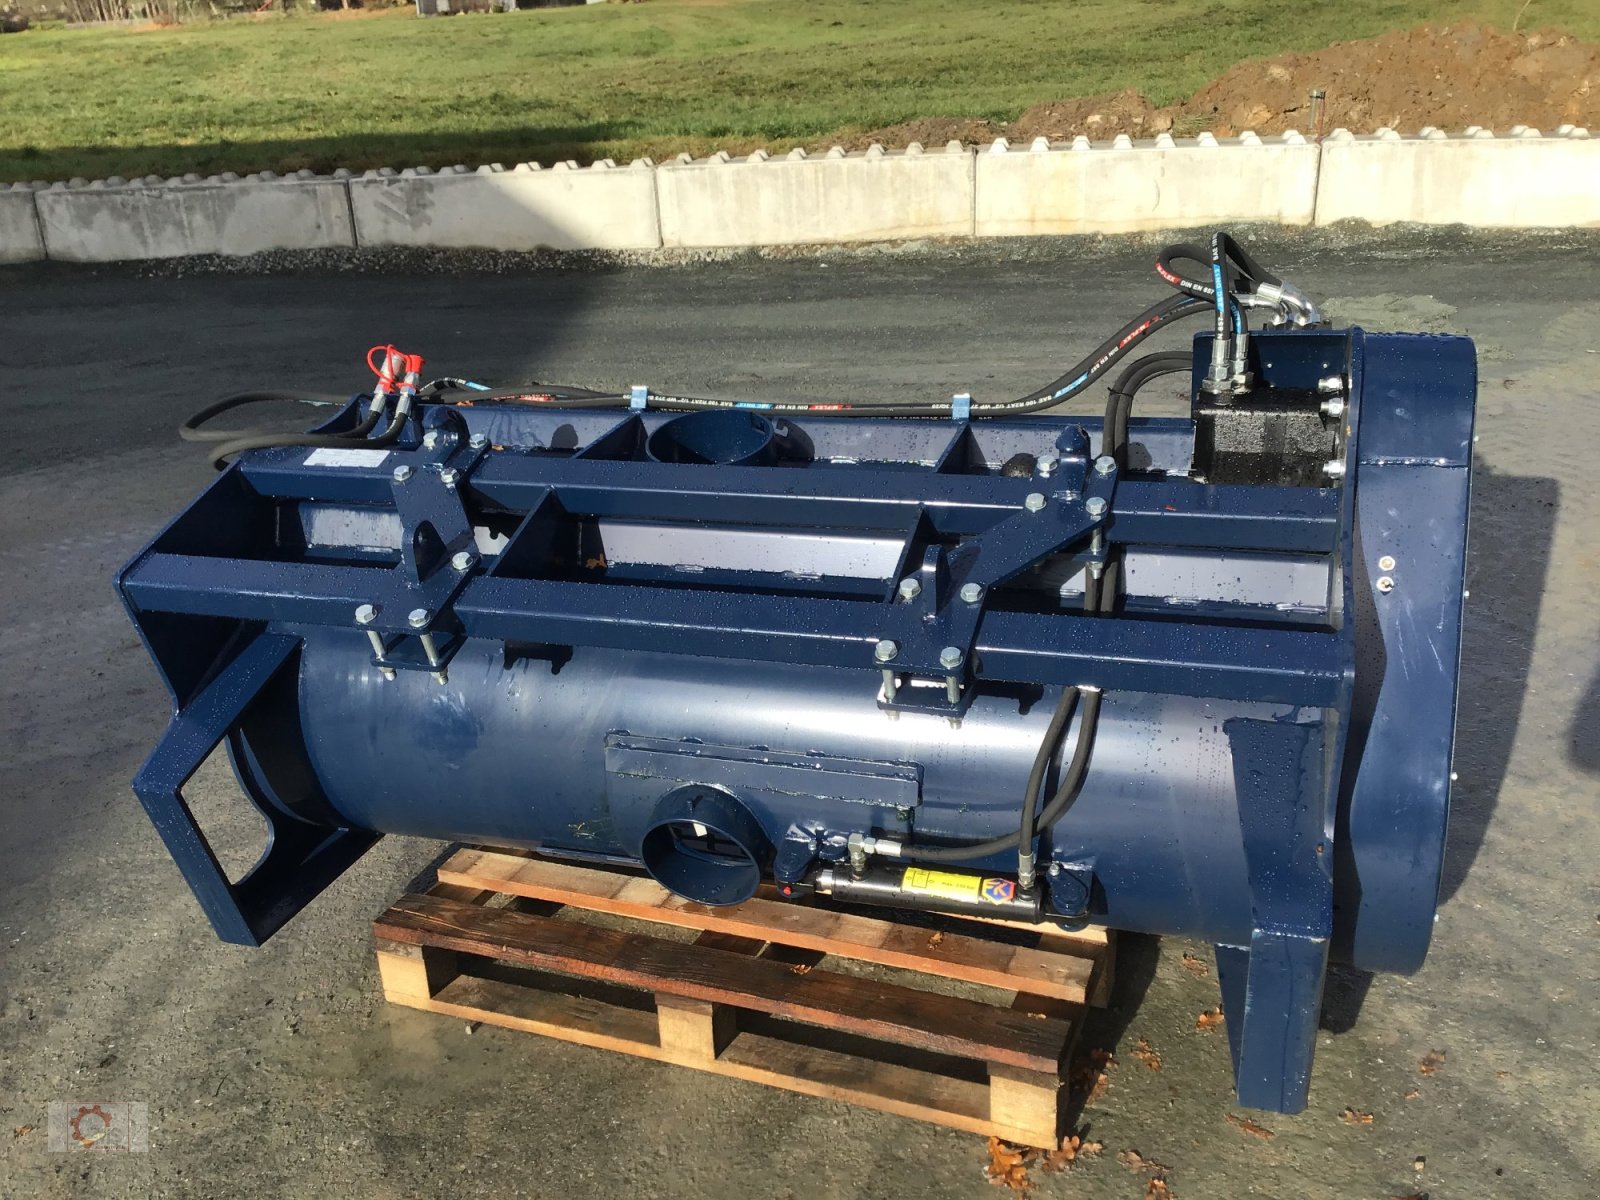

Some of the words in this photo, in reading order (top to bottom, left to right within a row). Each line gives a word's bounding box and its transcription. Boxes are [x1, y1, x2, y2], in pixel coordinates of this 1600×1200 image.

[1180, 280, 1193, 289] DIN
[1193, 283, 1203, 292] EN
[1108, 346, 1119, 358] DIN
[1100, 354, 1109, 366] EN
